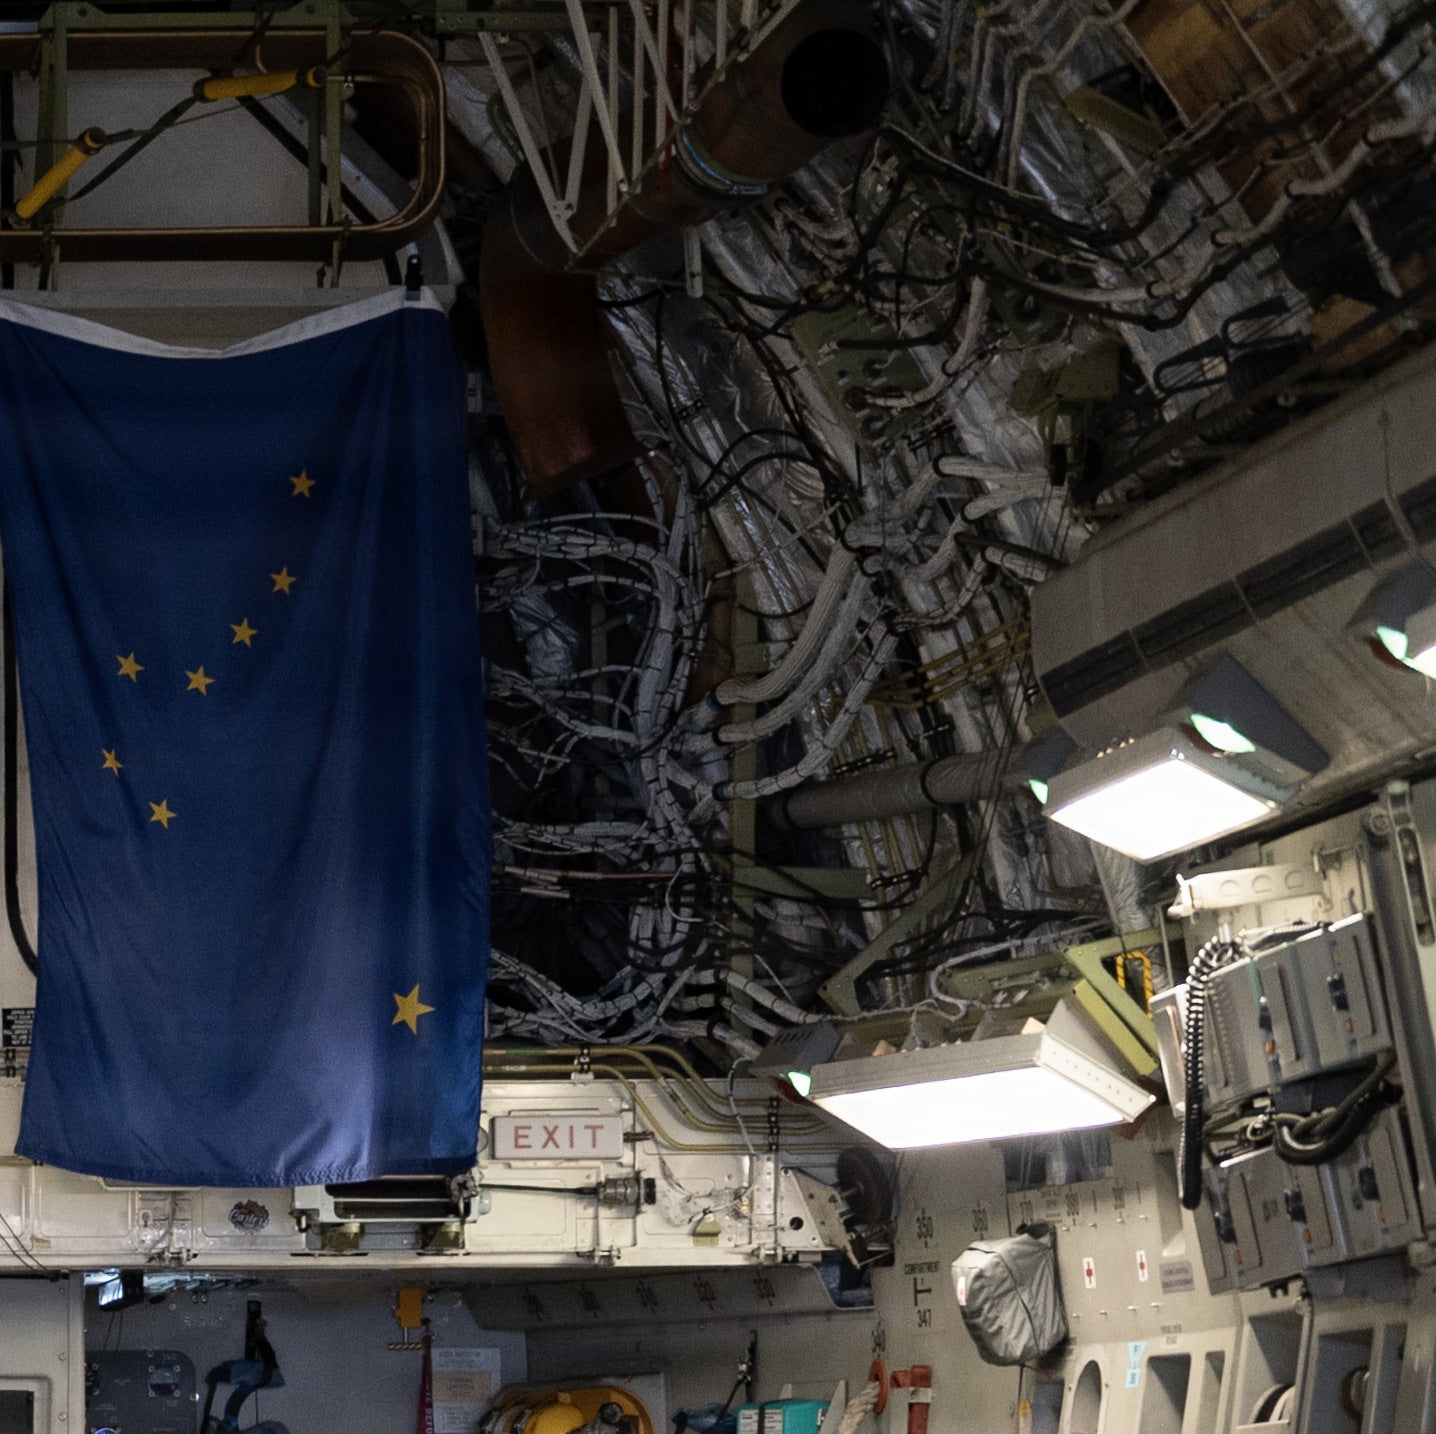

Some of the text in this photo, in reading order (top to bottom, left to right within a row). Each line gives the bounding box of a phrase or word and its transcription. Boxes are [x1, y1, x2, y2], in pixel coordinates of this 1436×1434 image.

[514, 1124, 605, 1149] EXIT
[916, 1215, 934, 1239] 350
[972, 1208, 989, 1232] 360
[753, 1277, 775, 1299] 330
[917, 1308, 932, 1329] 347
